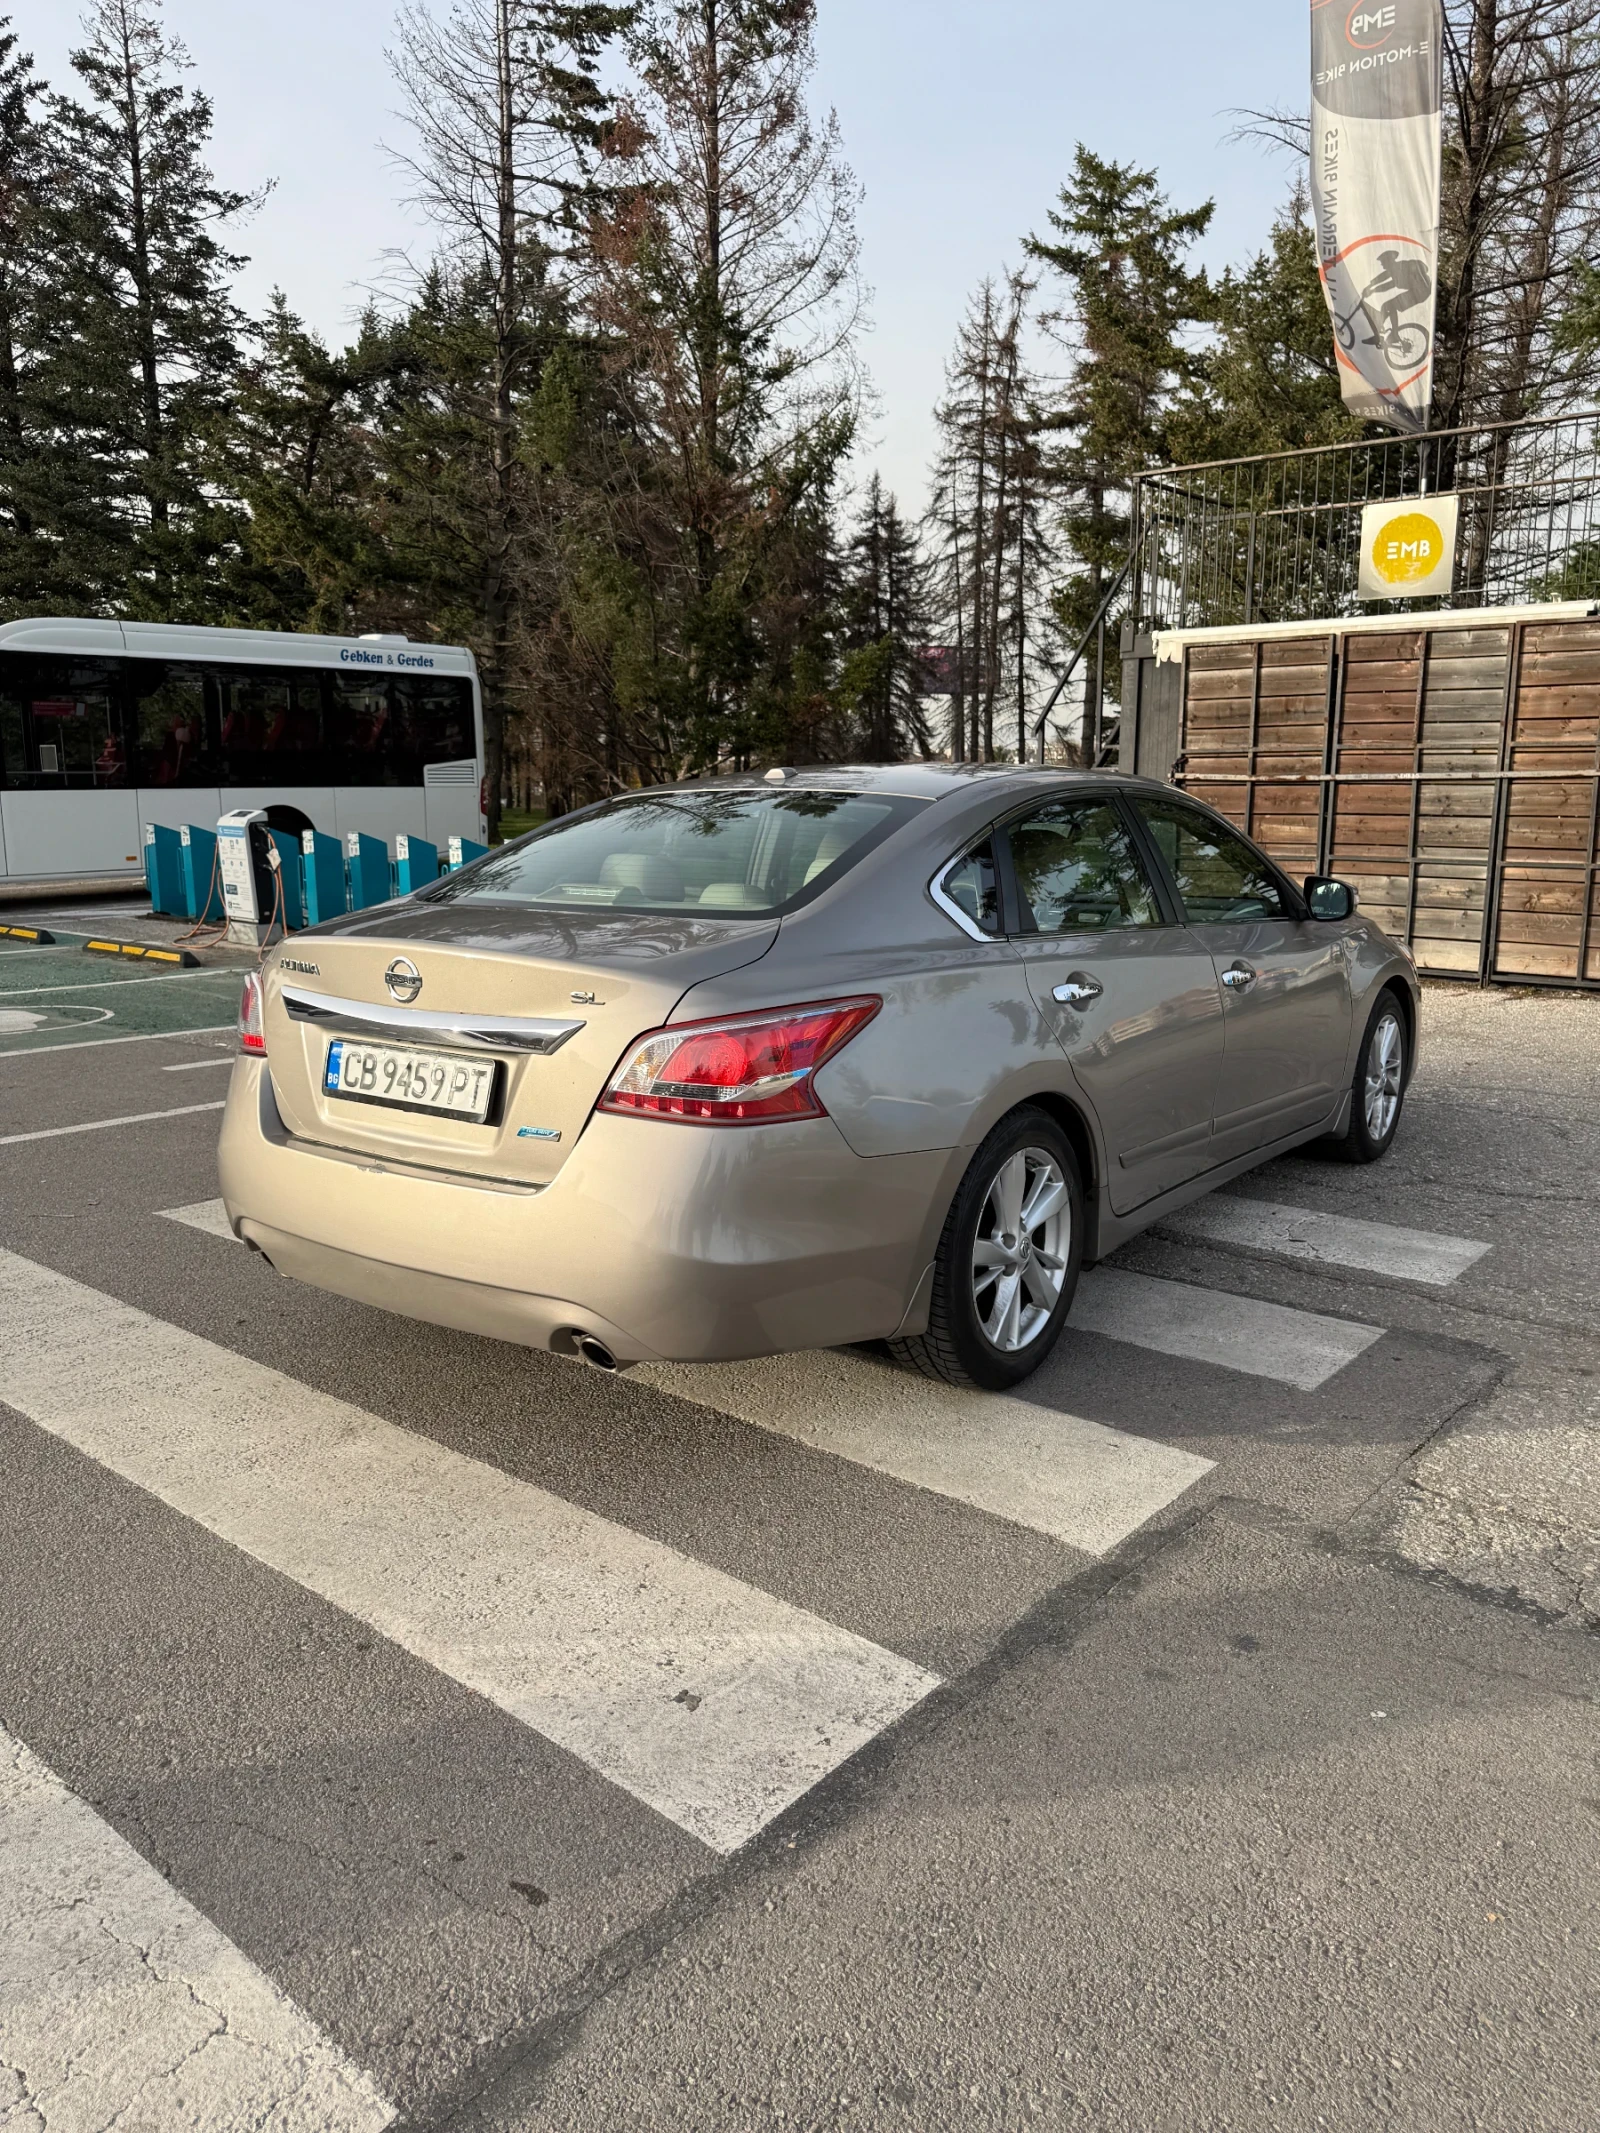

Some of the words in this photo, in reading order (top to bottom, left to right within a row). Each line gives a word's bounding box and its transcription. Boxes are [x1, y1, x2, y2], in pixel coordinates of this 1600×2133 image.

[1386, 539, 1431, 560] EMB
[340, 648, 383, 664] Gebken
[387, 654, 394, 665] &
[397, 653, 434, 668] Gerdes
[570, 991, 606, 1006] SL
[327, 1072, 339, 1085] BG
[344, 1050, 378, 1091] CB
[383, 1057, 447, 1102] 9459
[447, 1064, 488, 1109] PT
